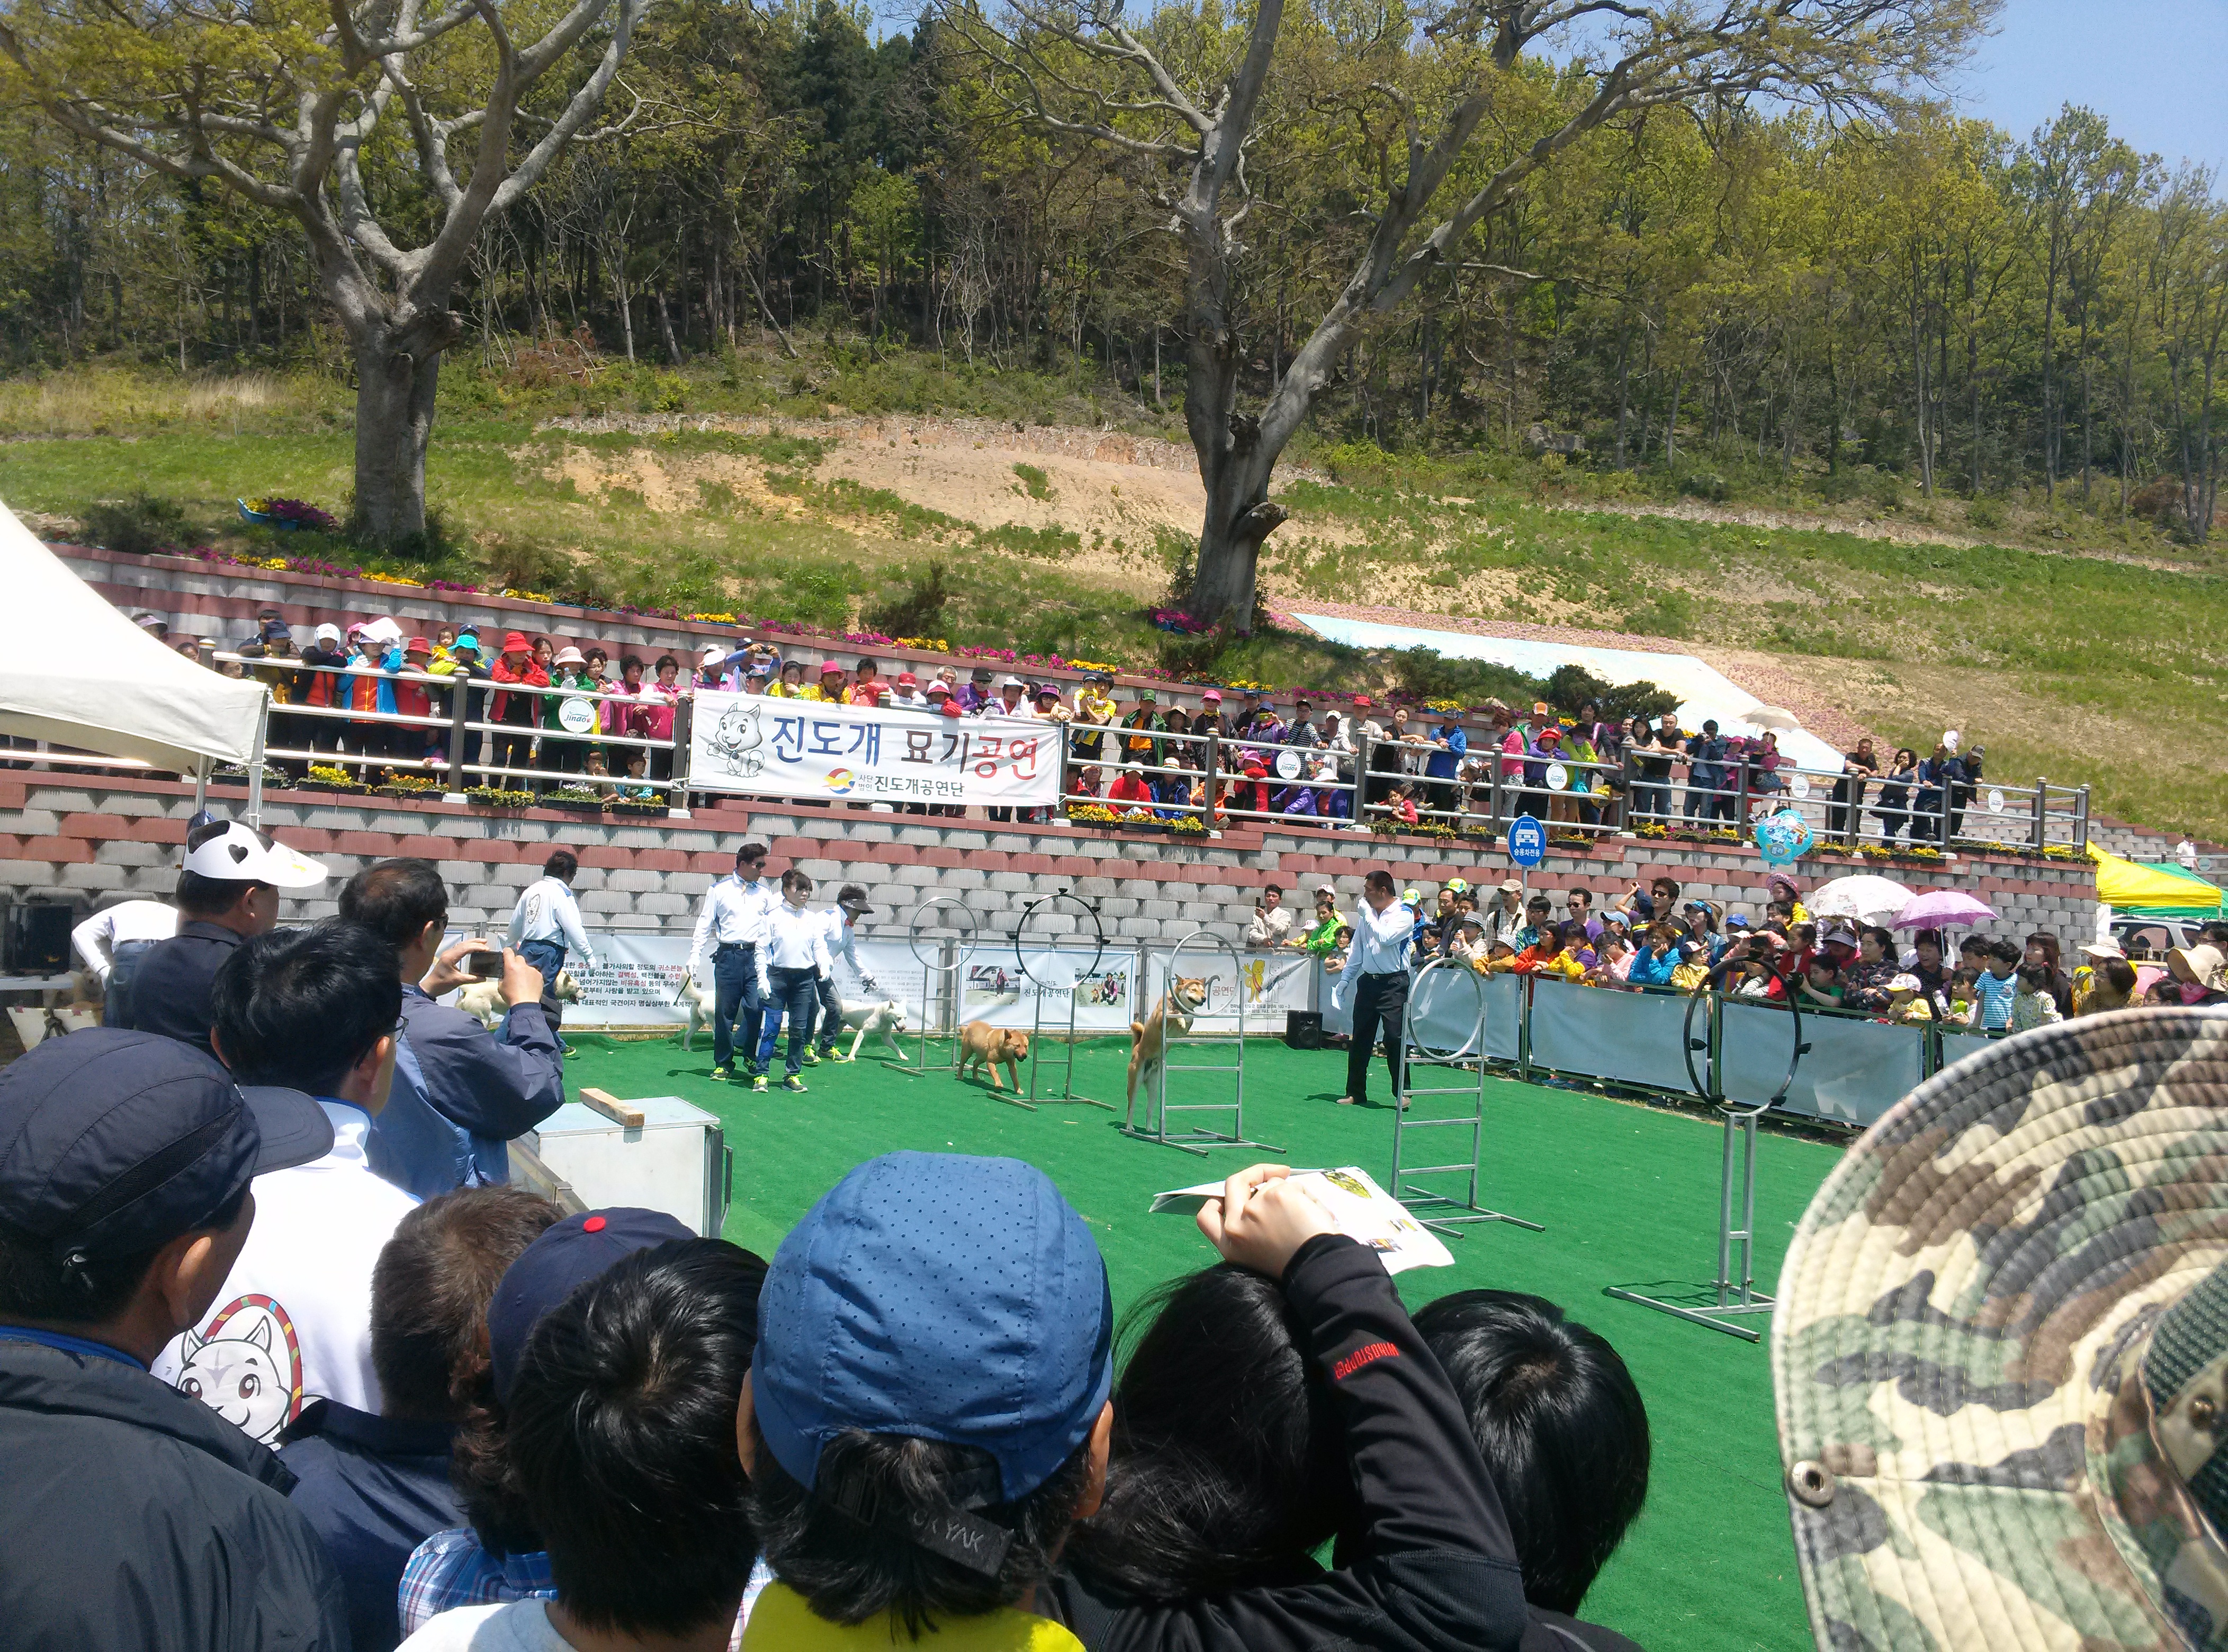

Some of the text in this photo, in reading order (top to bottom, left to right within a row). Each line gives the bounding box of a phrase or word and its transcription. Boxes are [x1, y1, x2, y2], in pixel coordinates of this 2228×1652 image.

[771, 716, 881, 767] 진도개
[858, 783, 873, 792] 법인
[875, 776, 965, 797] 진도개공연단
[1513, 848, 1540, 857] 승용차전용
[1333, 1342, 1399, 1380] WINDSTOPPER
